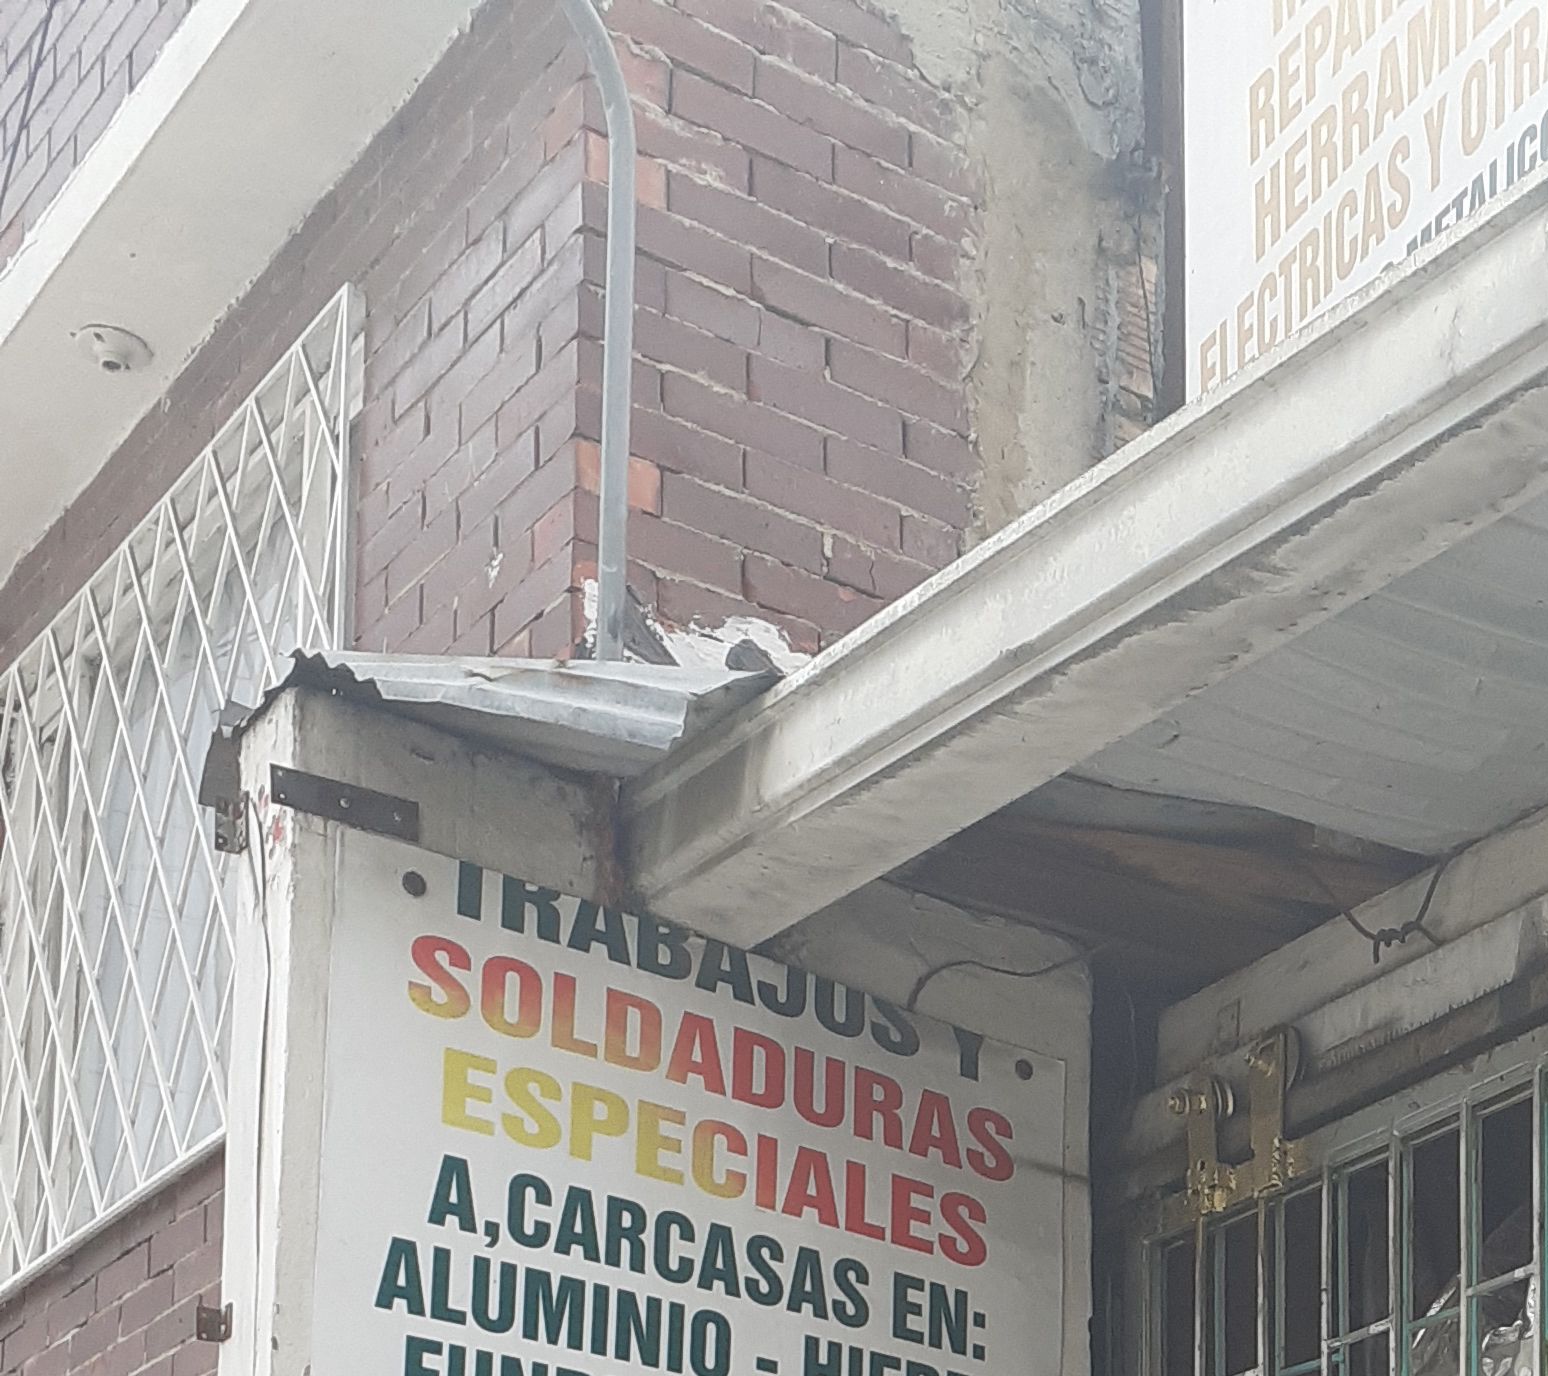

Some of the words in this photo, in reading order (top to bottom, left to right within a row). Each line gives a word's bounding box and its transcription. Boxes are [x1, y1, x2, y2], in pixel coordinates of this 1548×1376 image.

[1424, 92, 1448, 191] Y
[407, 933, 1016, 1184] SOLDADURAS
[454, 859, 921, 1057] TRABAJOS
[427, 1156, 869, 1330] A,CARCASAS
[892, 1272, 989, 1361] EN:
[441, 1046, 988, 1268] ESPECIALES
